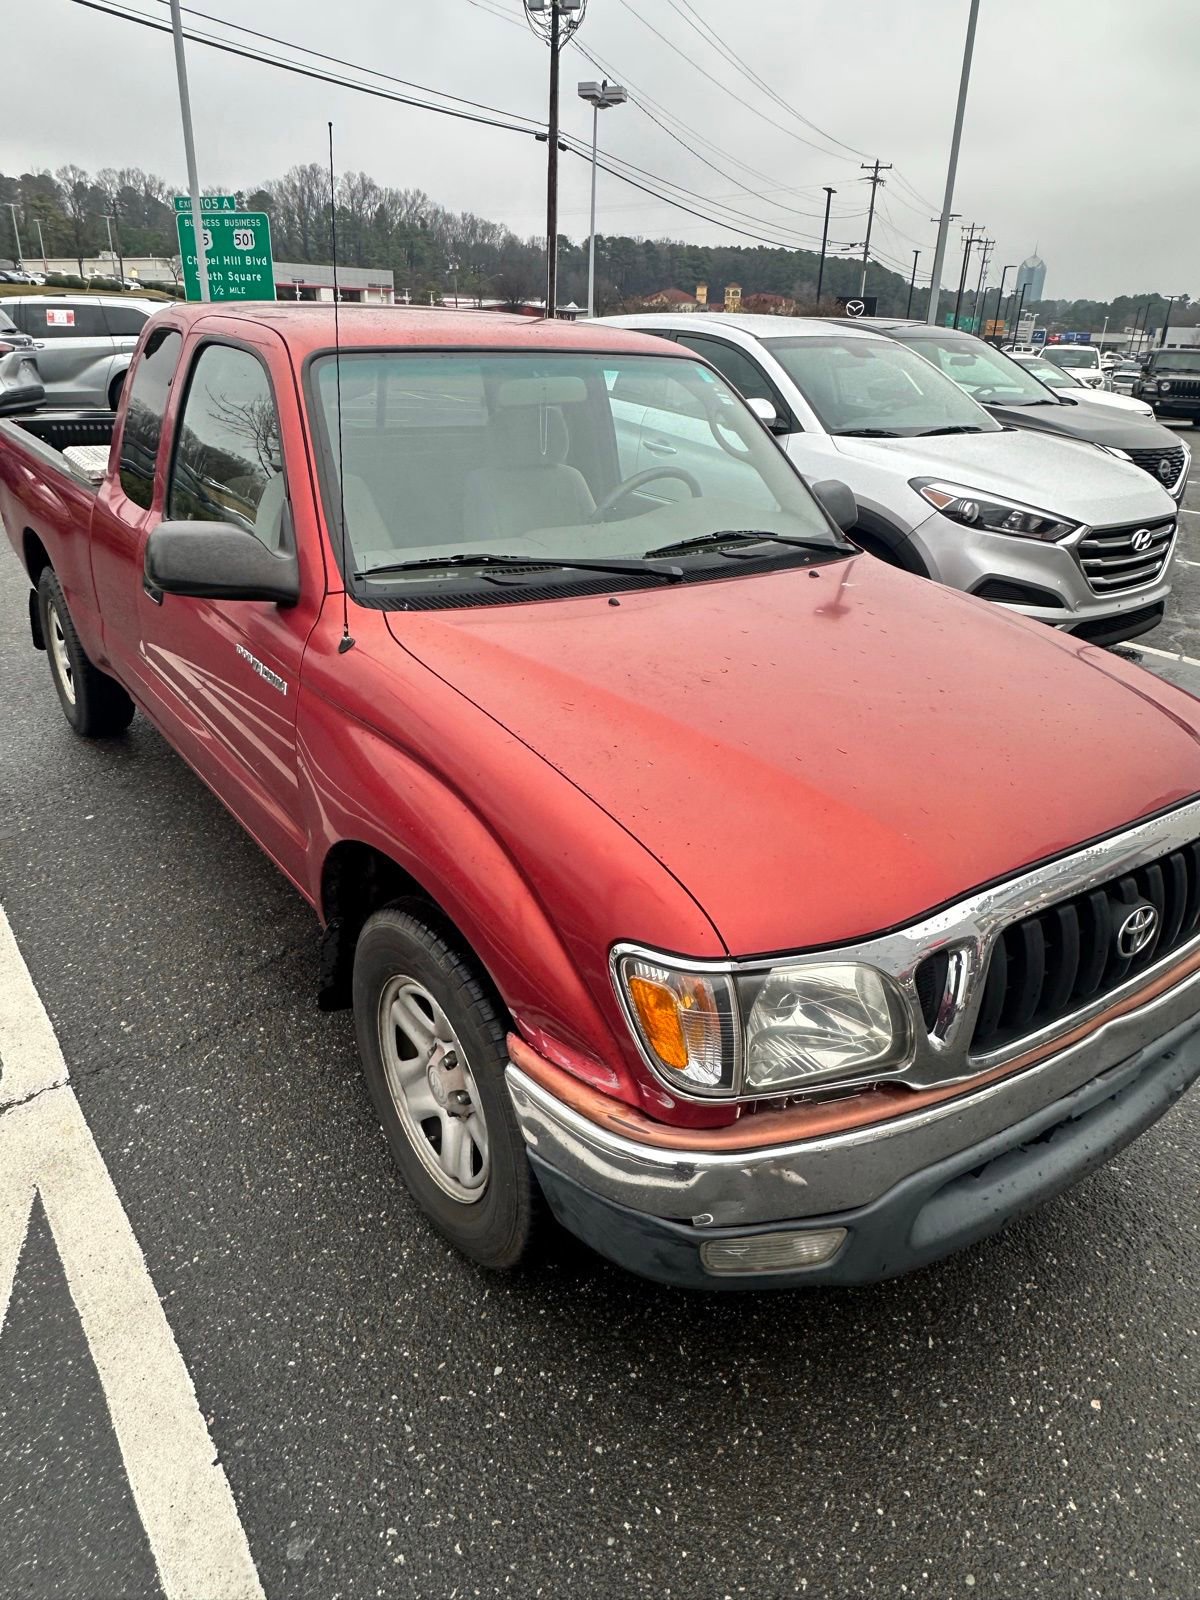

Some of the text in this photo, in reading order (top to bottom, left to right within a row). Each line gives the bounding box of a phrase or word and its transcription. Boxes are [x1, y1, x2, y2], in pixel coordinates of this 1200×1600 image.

[179, 198, 231, 209] EXI 105 A
[184, 219, 261, 227] BUNESS BUSINESS
[234, 233, 254, 246] 501
[186, 255, 267, 266] Chpel Hill Blvd
[195, 271, 262, 283] Suth Square
[229, 286, 246, 294] MILE
